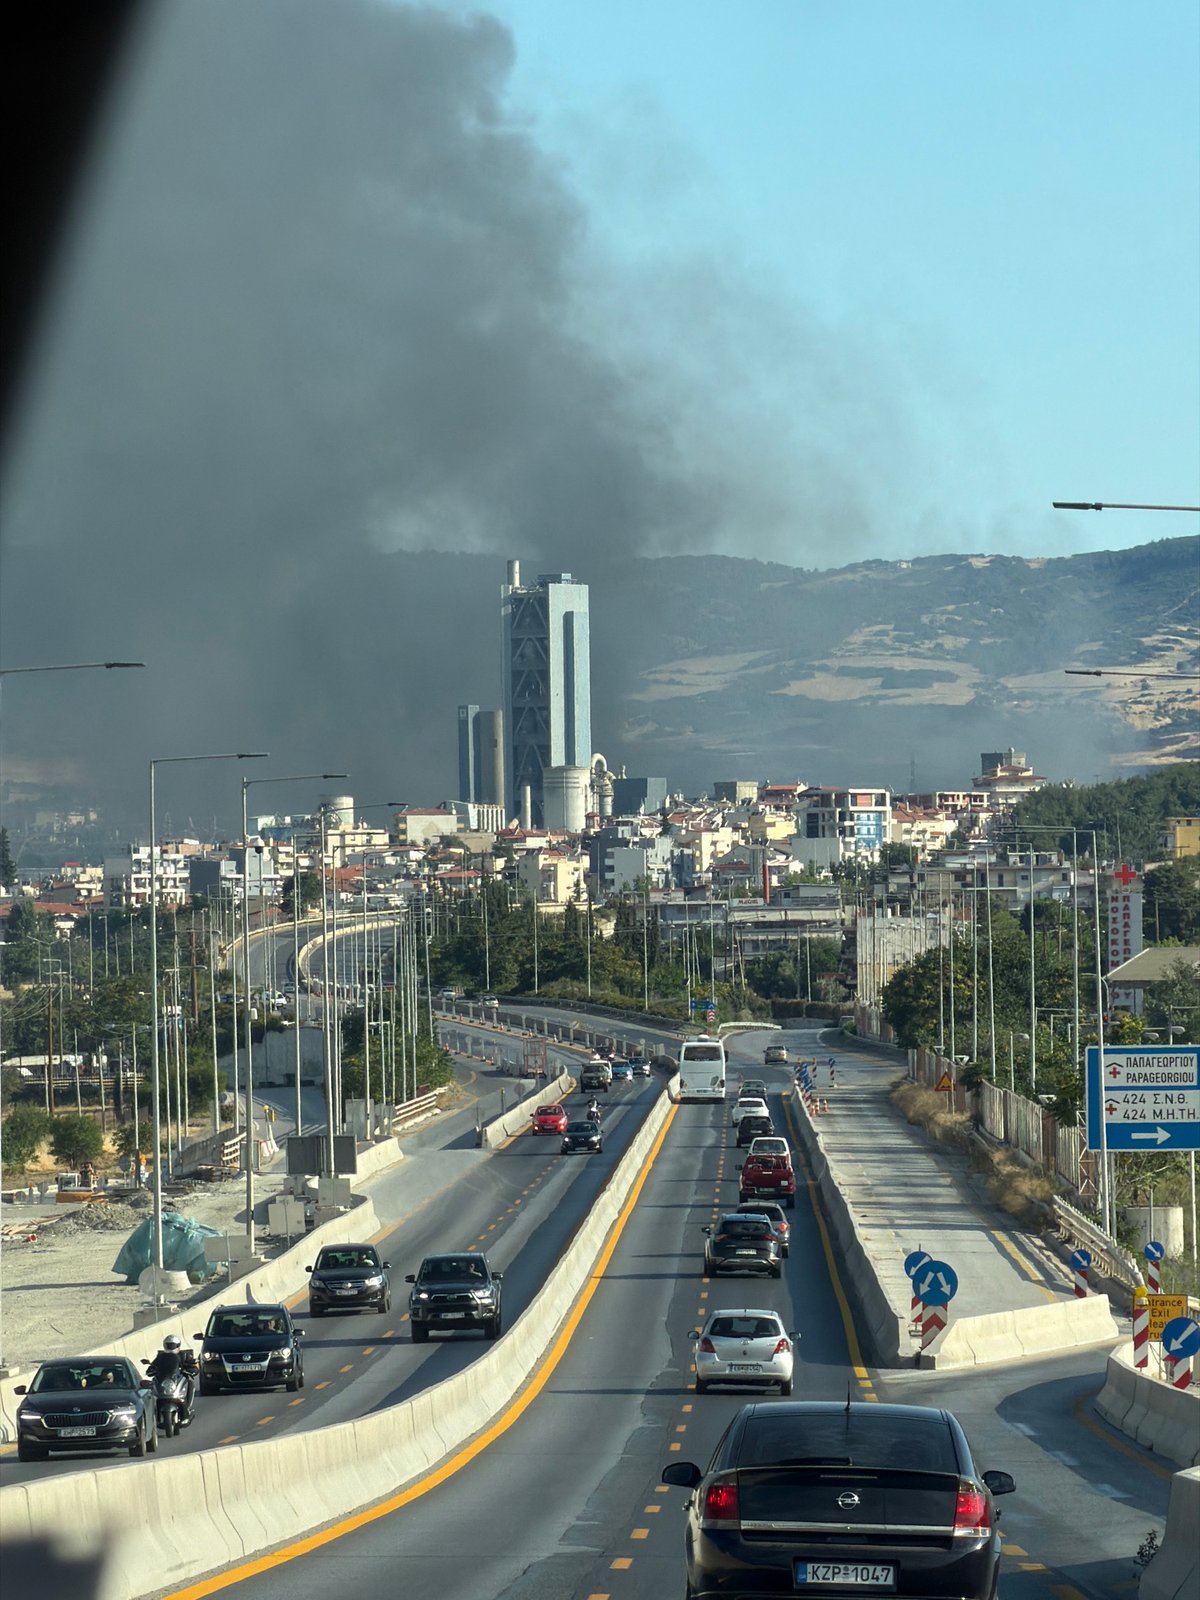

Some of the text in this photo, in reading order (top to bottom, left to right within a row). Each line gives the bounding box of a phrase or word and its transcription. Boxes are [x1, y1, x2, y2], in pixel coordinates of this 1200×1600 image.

[1111, 895, 1120, 999] ΝΟΣΟΚΟΜΟ
[1126, 1056, 1194, 1068] ΠΑΠΑΓΕΩΡΓΙΟΥ
[1126, 1072, 1194, 1083] PAPAGEORGIOU
[1123, 1093, 1188, 1105] 424 Σ.Ν.Θ.
[1123, 1109, 1146, 1120] 424
[1147, 1299, 1183, 1307] ntrance
[1151, 1308, 1170, 1317] Exit
